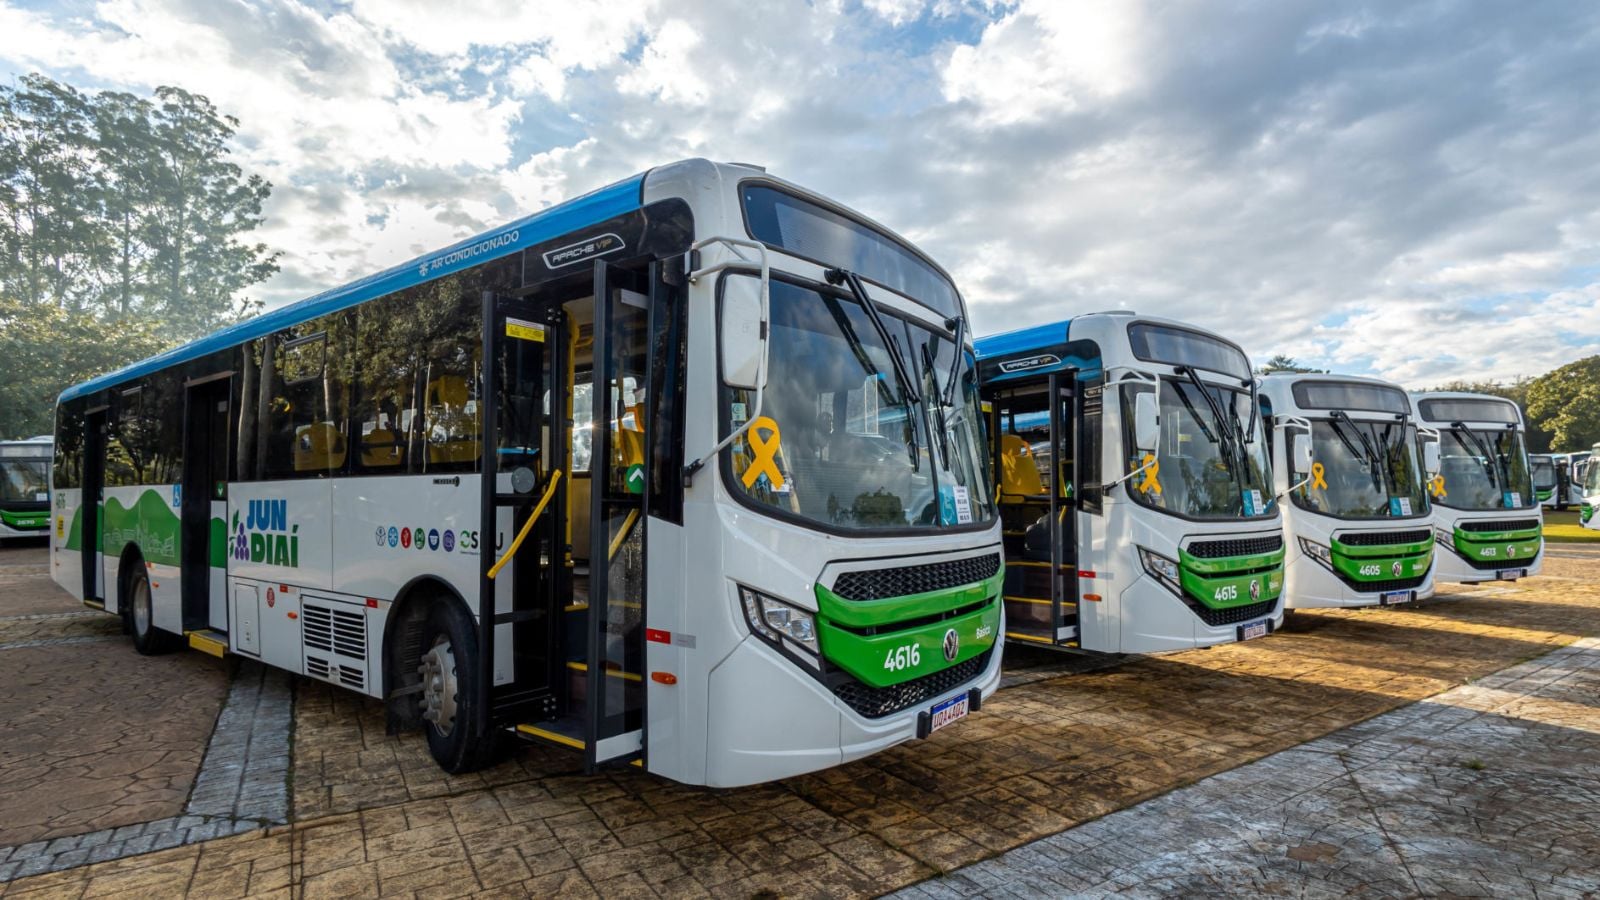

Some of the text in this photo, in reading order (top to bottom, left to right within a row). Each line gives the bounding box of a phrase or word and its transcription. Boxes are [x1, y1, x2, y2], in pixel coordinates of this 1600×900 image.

[430, 230, 520, 270] AR CONDICIONADO
[552, 238, 613, 263] APACHE VIP
[246, 499, 287, 531] JUN
[250, 524, 299, 568] DIAÍ
[1359, 564, 1381, 576] 4605
[1214, 584, 1238, 601] 4615
[883, 643, 920, 672] 4616
